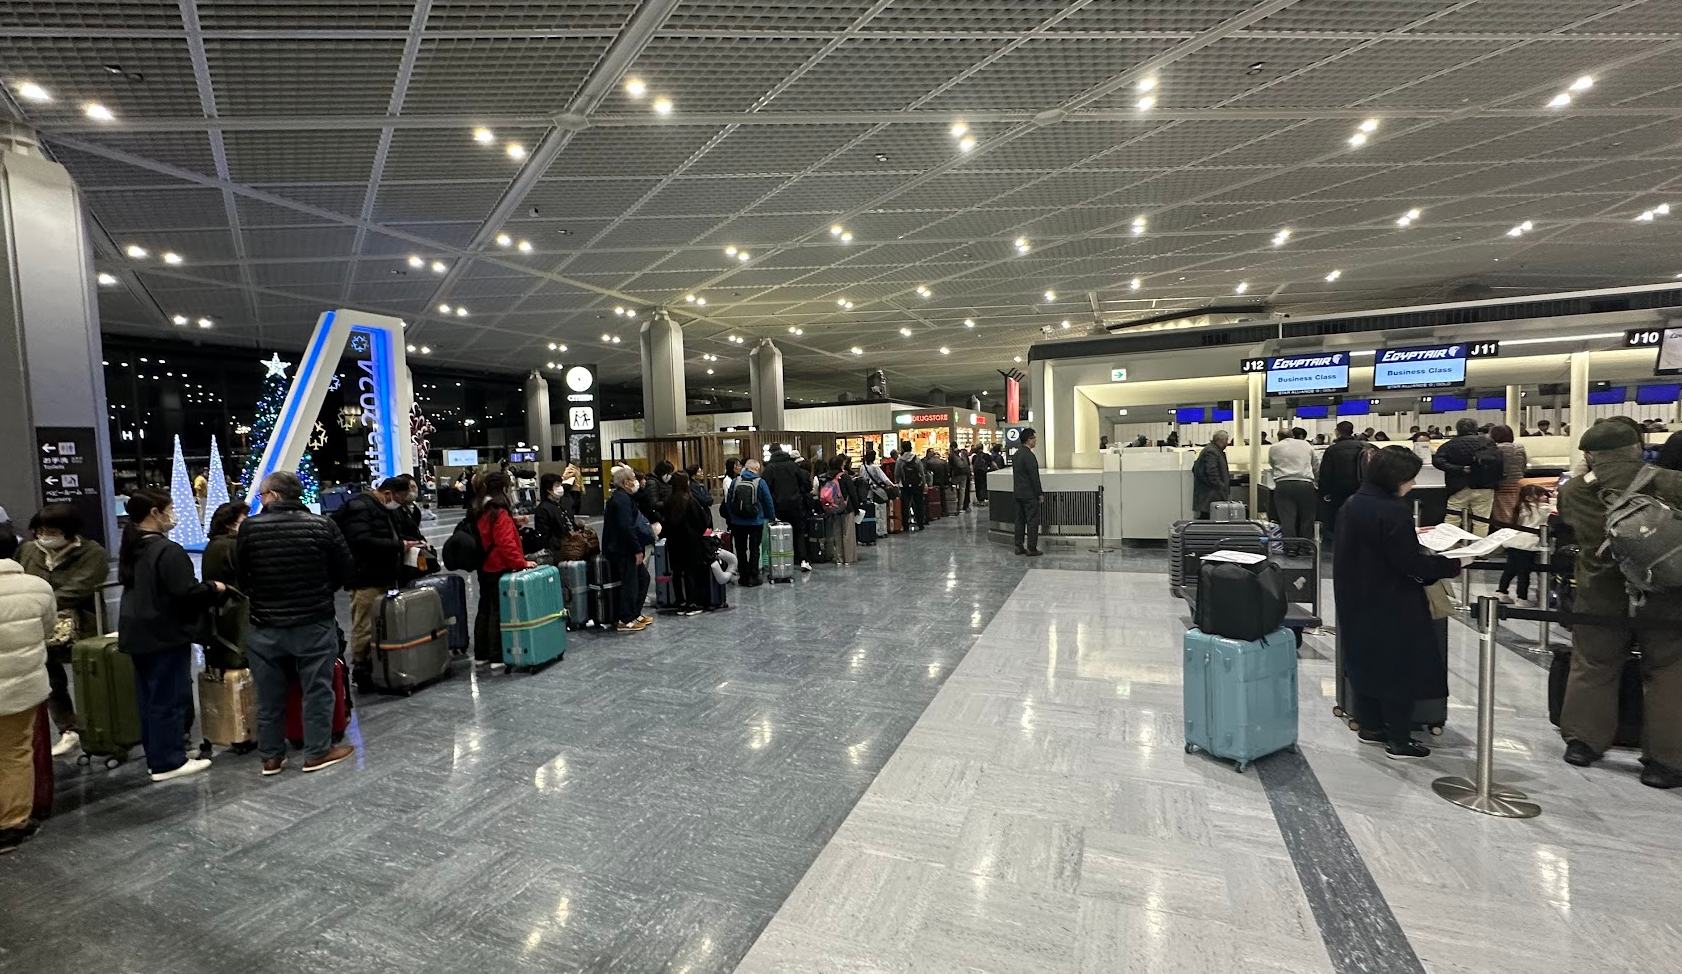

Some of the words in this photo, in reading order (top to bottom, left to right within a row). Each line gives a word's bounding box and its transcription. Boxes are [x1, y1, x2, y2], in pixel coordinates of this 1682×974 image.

[1629, 331, 1660, 345] J10
[1381, 349, 1448, 362] EGYPTAIR
[1470, 343, 1496, 356] J11
[1243, 361, 1264, 371] J12
[1272, 357, 1331, 369] EGYPTAIR
[1428, 366, 1452, 374] Class
[357, 359, 384, 427] 2024
[912, 414, 948, 422] DRUGSTORE
[1010, 430, 1016, 439] 2
